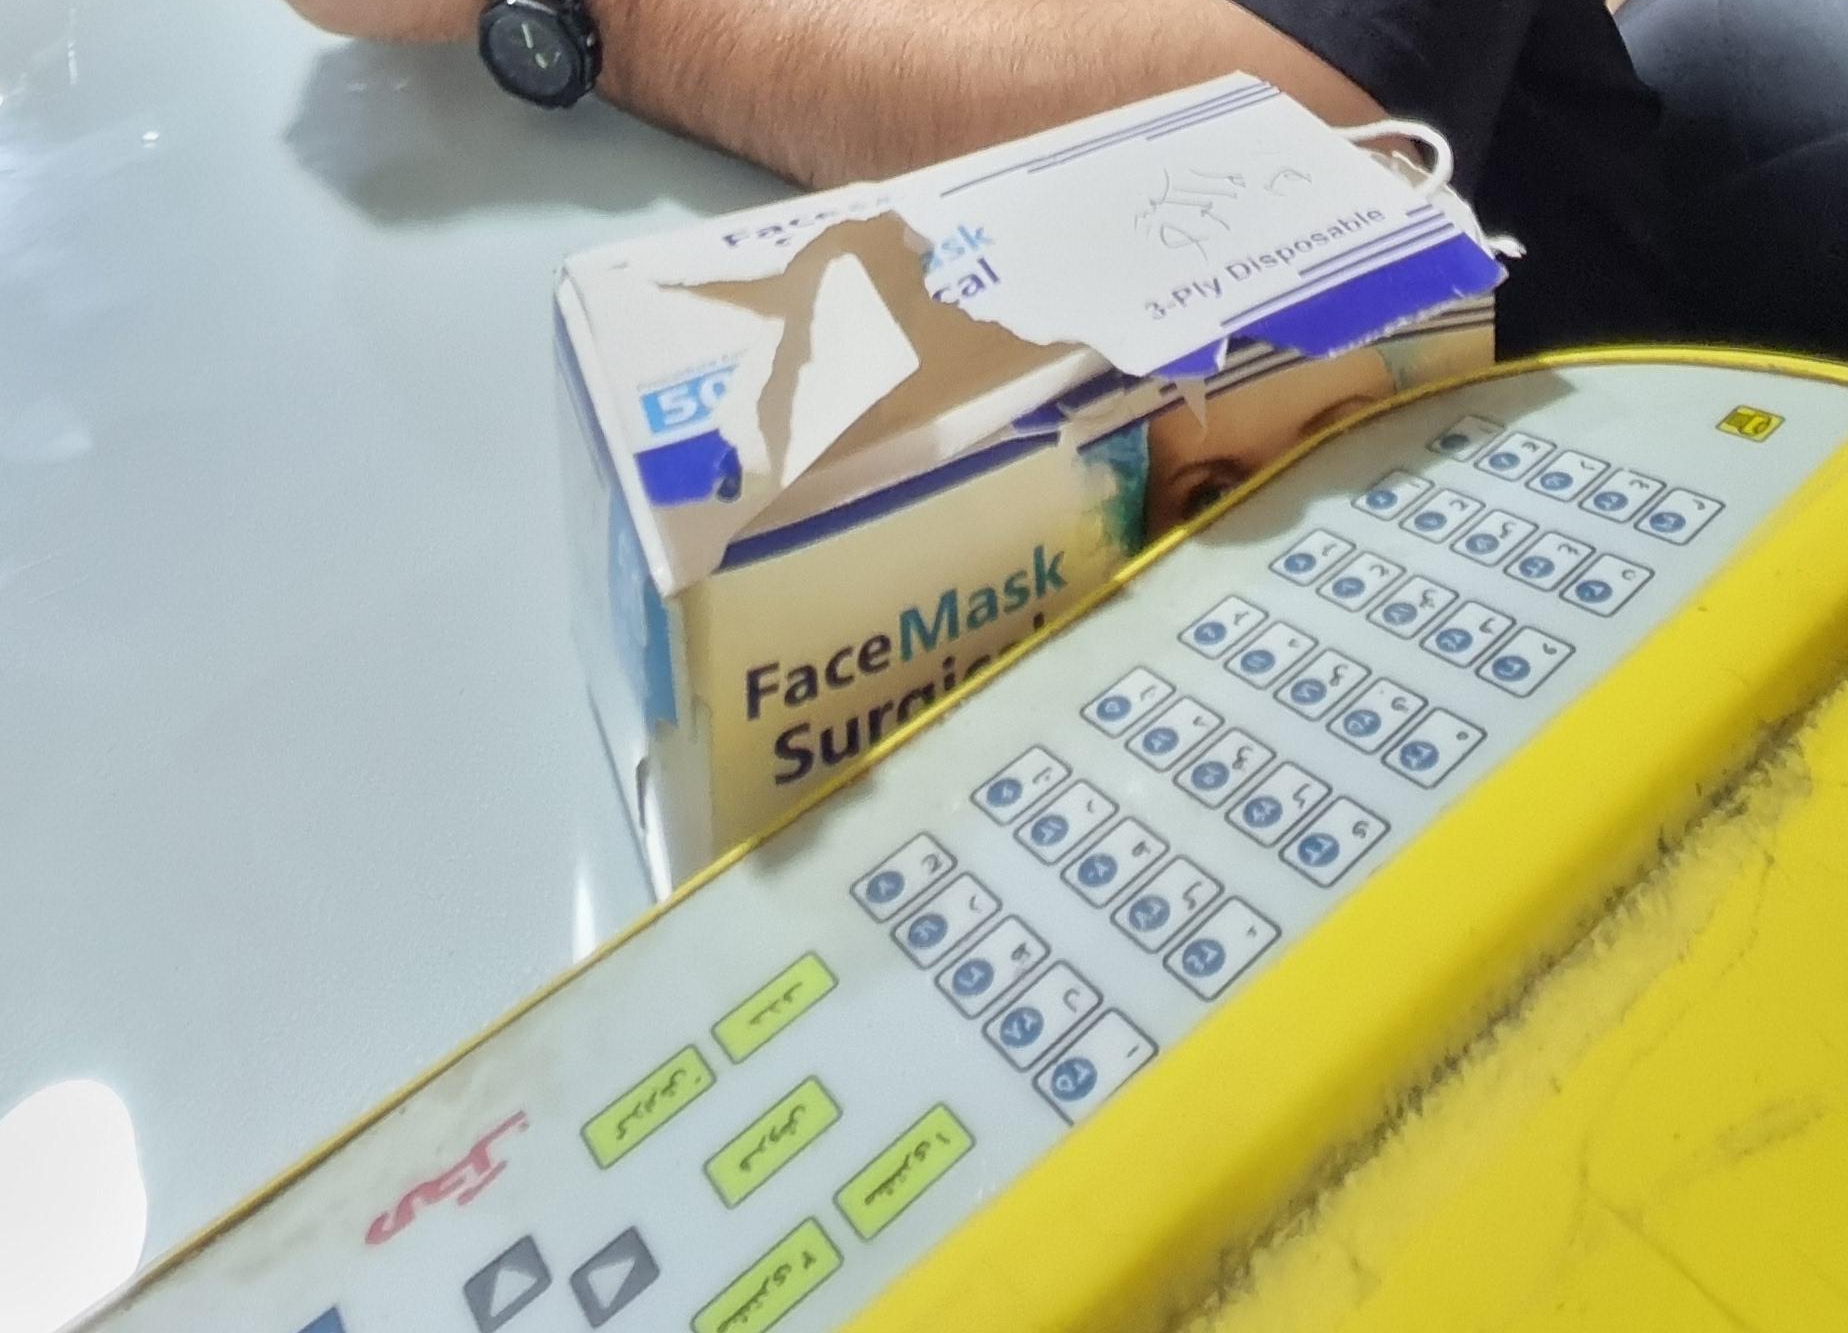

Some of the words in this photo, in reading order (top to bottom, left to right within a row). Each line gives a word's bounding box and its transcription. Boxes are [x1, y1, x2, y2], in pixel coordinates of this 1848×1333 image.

[1144, 277, 1223, 321] 3-Ply
[1225, 207, 1387, 283] Disposable
[746, 544, 1069, 722] FaceMask
[615, 1067, 688, 1141] گزارش
[739, 1103, 808, 1174] فروش
[864, 1138, 932, 1207] مشتری
[715, 1262, 794, 1333] مشتری
[799, 1249, 818, 1272] ۲
